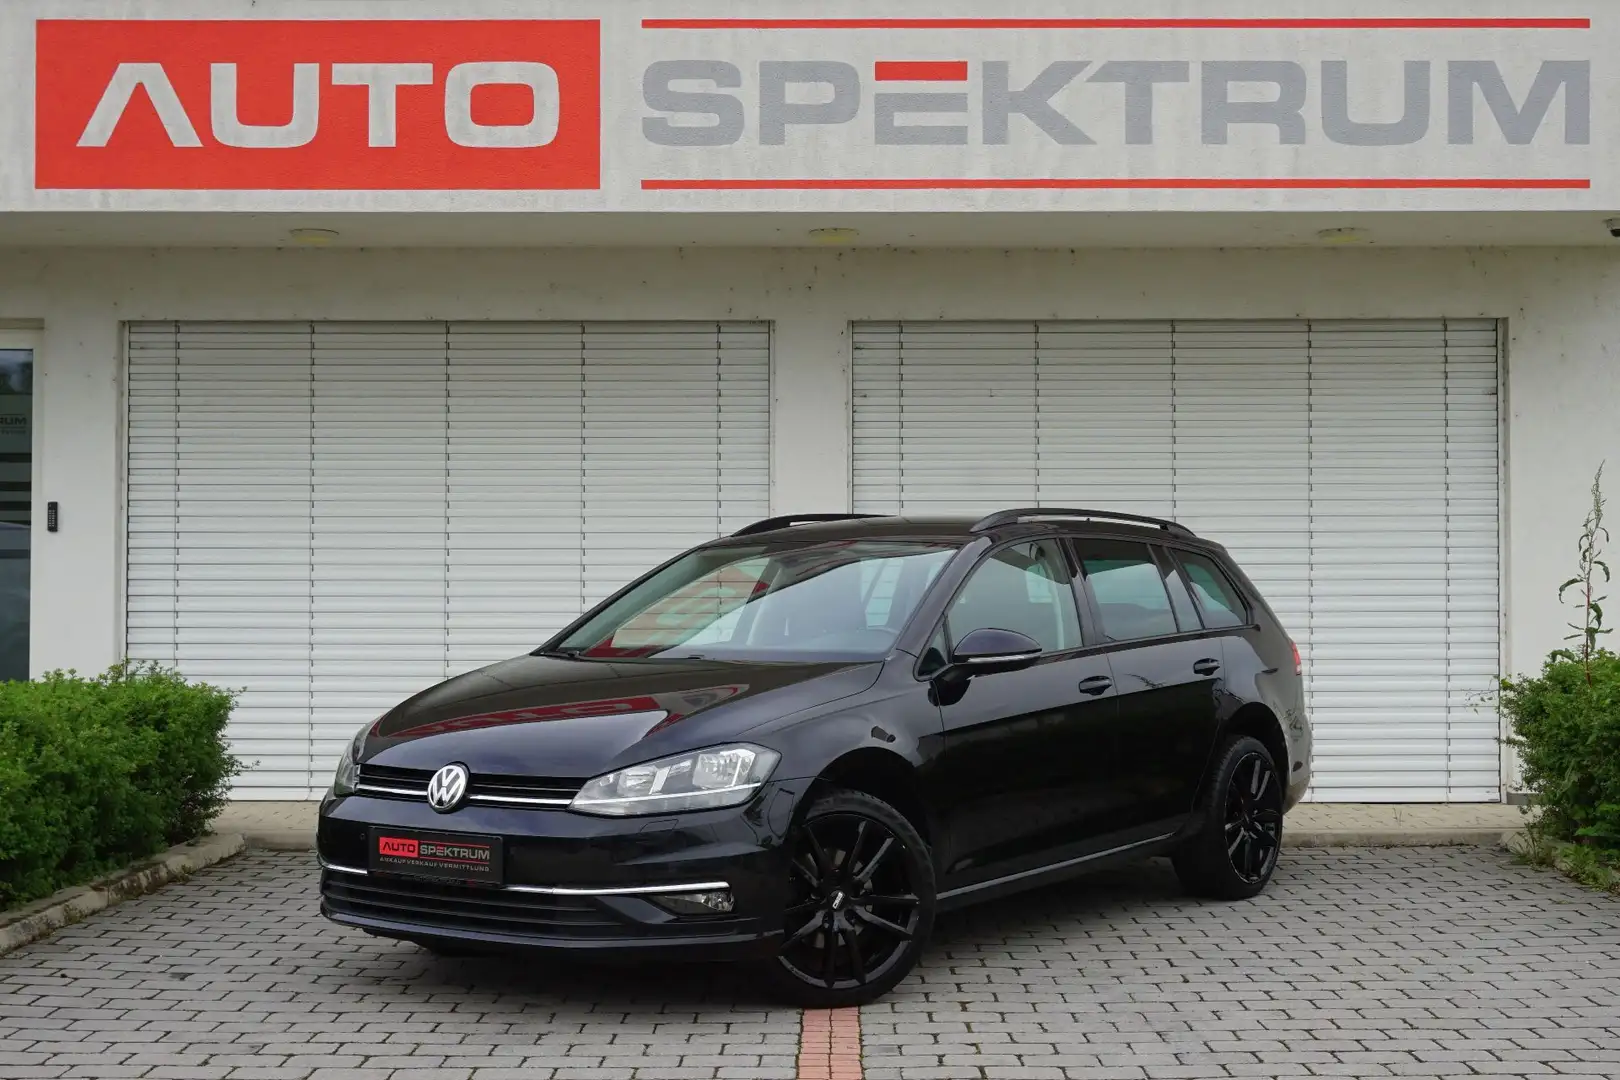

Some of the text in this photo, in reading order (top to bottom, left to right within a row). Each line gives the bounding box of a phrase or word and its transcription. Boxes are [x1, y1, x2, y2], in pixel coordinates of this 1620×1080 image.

[77, 60, 1590, 148] AUTO SPEKTRUM
[382, 841, 490, 860] AUTO SPEKTRUM
